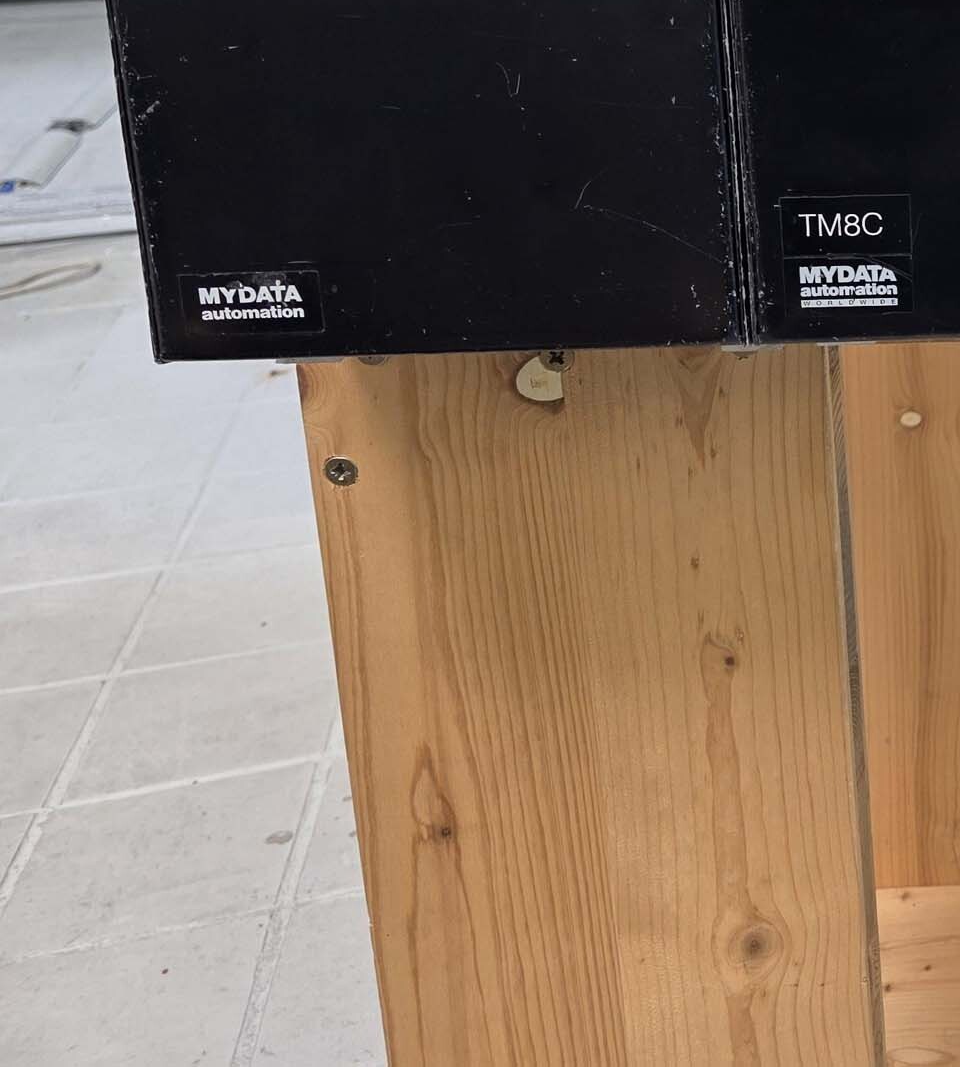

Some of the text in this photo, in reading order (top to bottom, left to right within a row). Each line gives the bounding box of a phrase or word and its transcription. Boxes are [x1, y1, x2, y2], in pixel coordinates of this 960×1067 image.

[798, 212, 883, 237] TM8C
[799, 265, 897, 284] MYDATA
[198, 283, 303, 305] MYDATA
[800, 283, 898, 298] automation
[201, 305, 305, 321] automation
